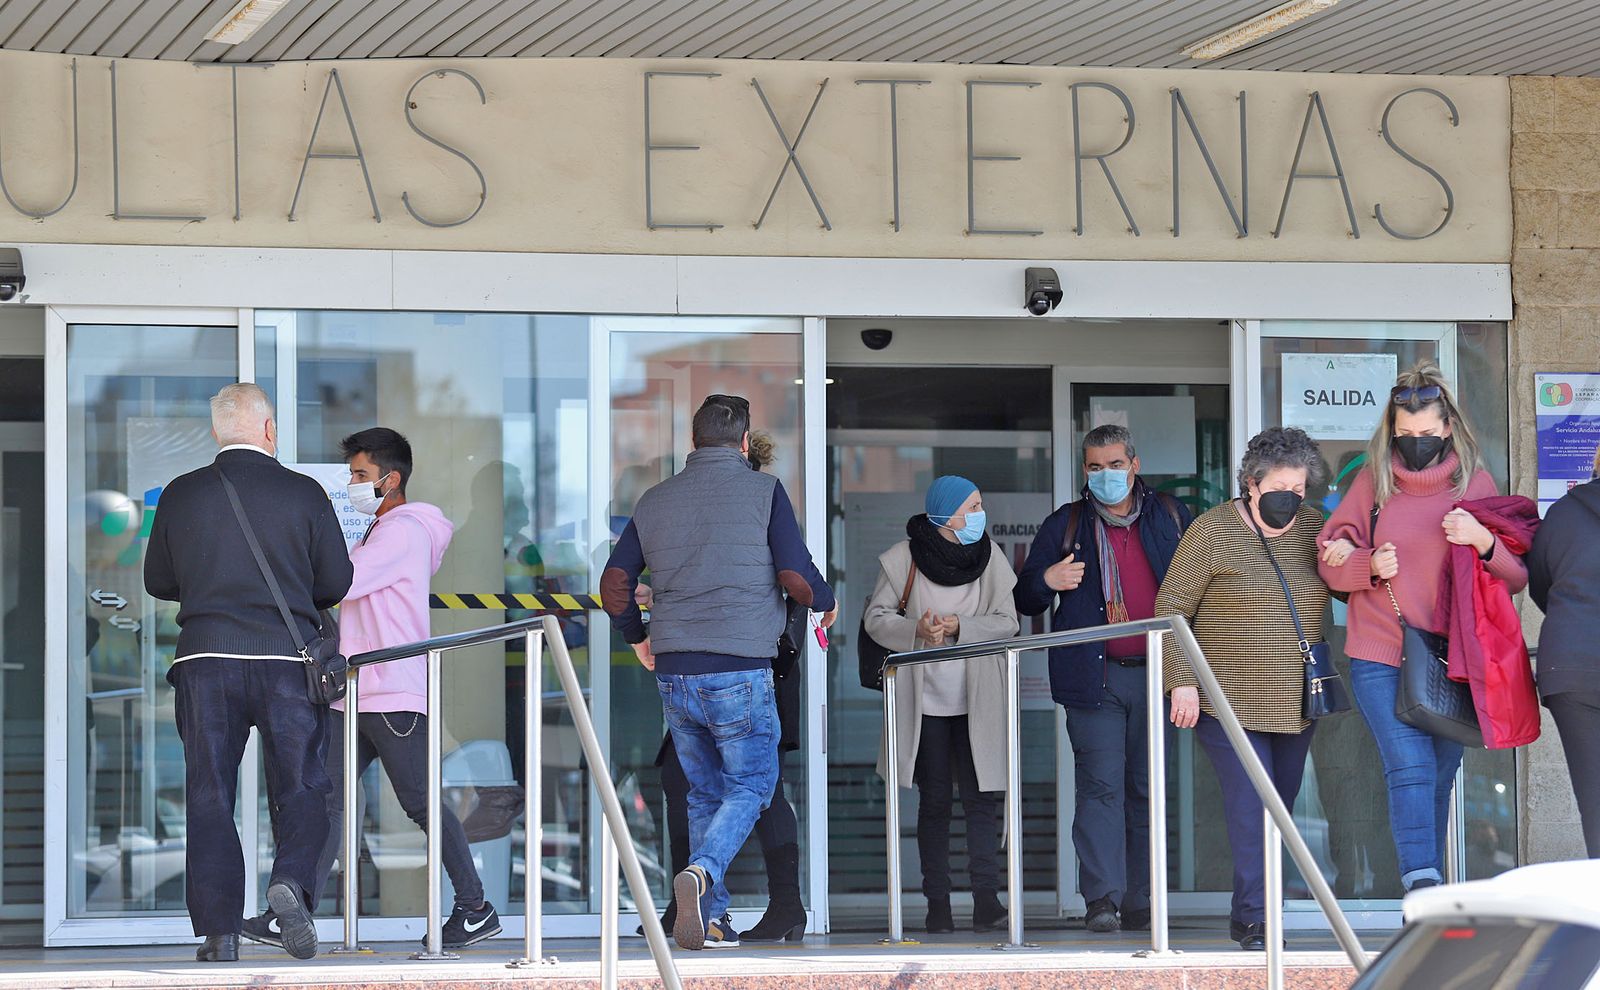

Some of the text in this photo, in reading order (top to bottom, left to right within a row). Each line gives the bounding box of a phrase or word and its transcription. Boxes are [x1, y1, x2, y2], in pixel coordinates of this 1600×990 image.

[644, 71, 1459, 240] EXTERNAS
[1303, 389, 1376, 406] SALIDA
[343, 518, 361, 526] uso
